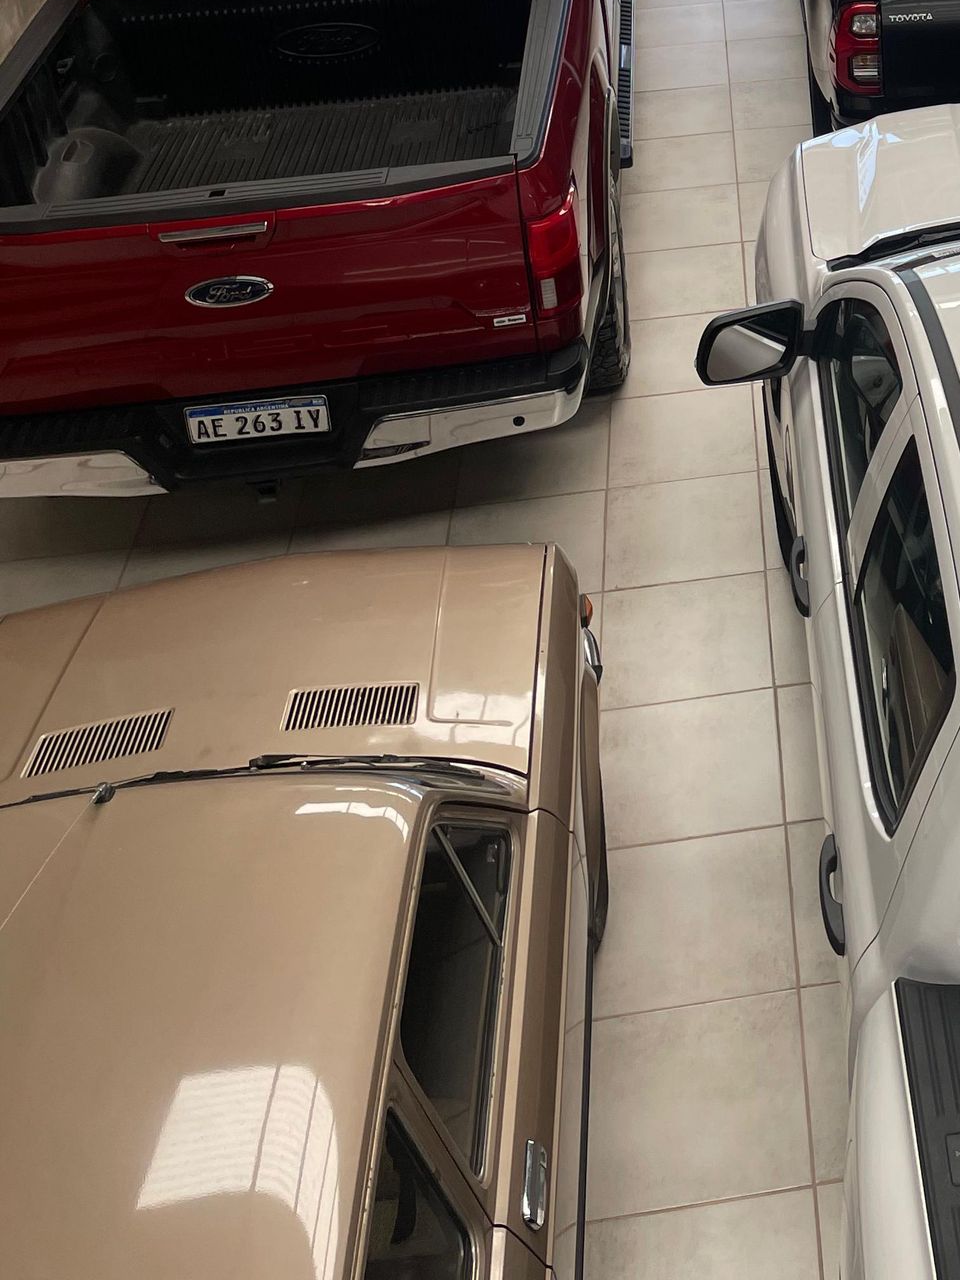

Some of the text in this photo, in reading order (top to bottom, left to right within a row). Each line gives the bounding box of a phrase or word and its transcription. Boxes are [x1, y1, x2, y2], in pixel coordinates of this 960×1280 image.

[888, 13, 933, 23] TOYOTA
[205, 284, 252, 303] Ford
[197, 408, 320, 440] AE 263 IY
